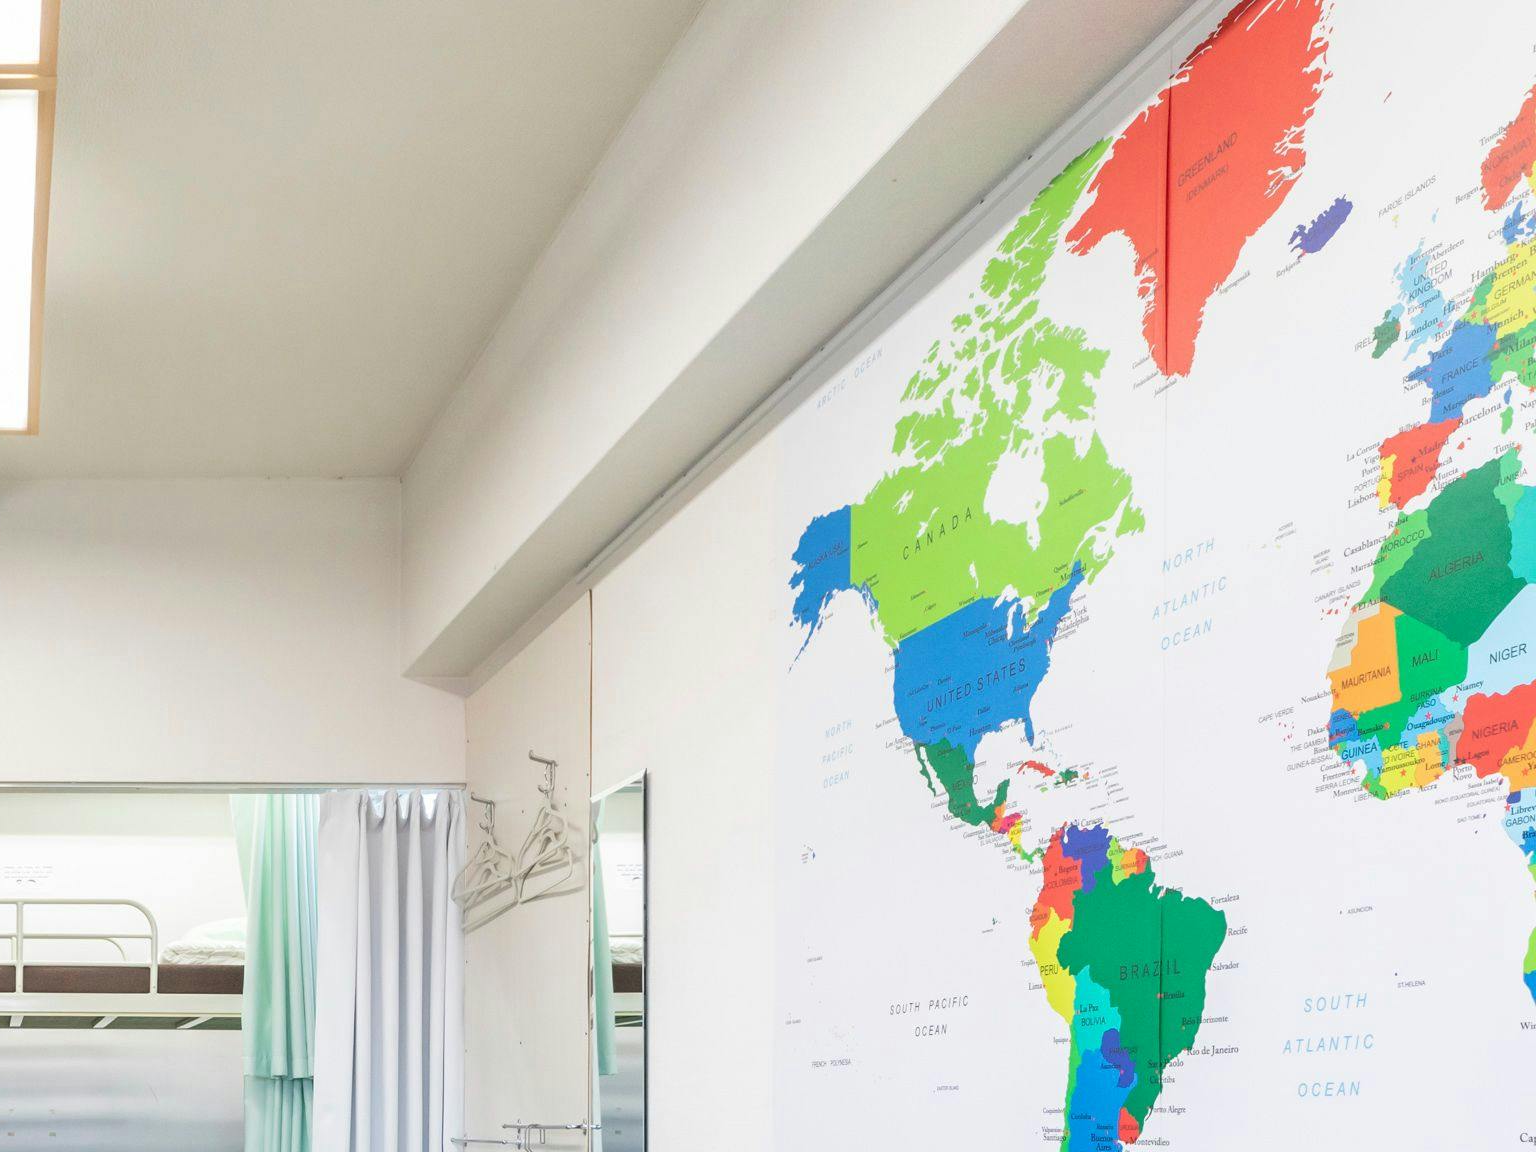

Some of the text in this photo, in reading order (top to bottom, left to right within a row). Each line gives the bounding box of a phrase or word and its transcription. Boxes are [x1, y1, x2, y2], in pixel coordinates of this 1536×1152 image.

[1404, 175, 1437, 201] ISLANDS
[1455, 185, 1479, 205] Bergen
[1431, 239, 1464, 263] Aberdeen
[1413, 260, 1448, 286] UNITED
[1471, 253, 1516, 283] Hamburg
[1490, 259, 1528, 285] Bremen
[1408, 269, 1453, 301] KINGDOM
[1404, 317, 1439, 342] London
[1442, 357, 1479, 384] FRANCE
[1459, 402, 1502, 426] Barcelona
[1364, 454, 1380, 465] Vigo
[1361, 465, 1380, 478] Porto
[1347, 493, 1375, 509] Lisbon
[903, 506, 972, 561] CANADA
[1380, 529, 1424, 553] MOROCCO
[1161, 537, 1215, 573] NORTH
[1343, 535, 1387, 558] Casablanca
[1427, 550, 1484, 583] ALGERIA
[1337, 580, 1361, 595] ISLANDS
[1152, 576, 1228, 620] ATLANTIC
[1161, 618, 1213, 651] OCEAN
[1412, 648, 1439, 668] MALI
[1489, 643, 1528, 665] NIGER
[927, 683, 972, 713] UNITED
[977, 658, 1026, 692] STATES
[1341, 666, 1392, 690] MAURITANIA
[1456, 680, 1484, 694] Niamey
[1258, 706, 1295, 724] CAPE VERDE
[825, 719, 852, 738] NORTH
[1471, 719, 1519, 740] NIGERIA
[822, 743, 854, 764] PACIFIC
[1341, 742, 1378, 760] GUINEA
[1415, 738, 1441, 751] GHANA
[1287, 753, 1334, 772] GUINEA-BISSAU
[823, 770, 850, 789] OCEAN
[1315, 775, 1361, 793] SIERRA LEONE
[1354, 790, 1379, 803] LIBERIA
[1505, 815, 1536, 828] GABON
[1210, 893, 1240, 906] Fortaleza
[1227, 926, 1248, 938] Recife
[1040, 964, 1059, 977] PERU
[1119, 959, 1181, 981] BRAZIL
[1212, 960, 1240, 972] Salvador
[1028, 982, 1043, 991] Lima
[890, 995, 969, 1016] SOUTH PACIFIC
[1302, 992, 1369, 1014] SOUTH
[914, 1023, 948, 1038] OCEAN
[1081, 1016, 1106, 1027] BOLIVIA
[1186, 1045, 1239, 1057] Rio de Janeiro
[1282, 1033, 1376, 1055] ATLANTIC
[1297, 1080, 1362, 1098] OCEAN
[1168, 1106, 1186, 1116] Alegre
[1042, 1133, 1067, 1143] Santiago
